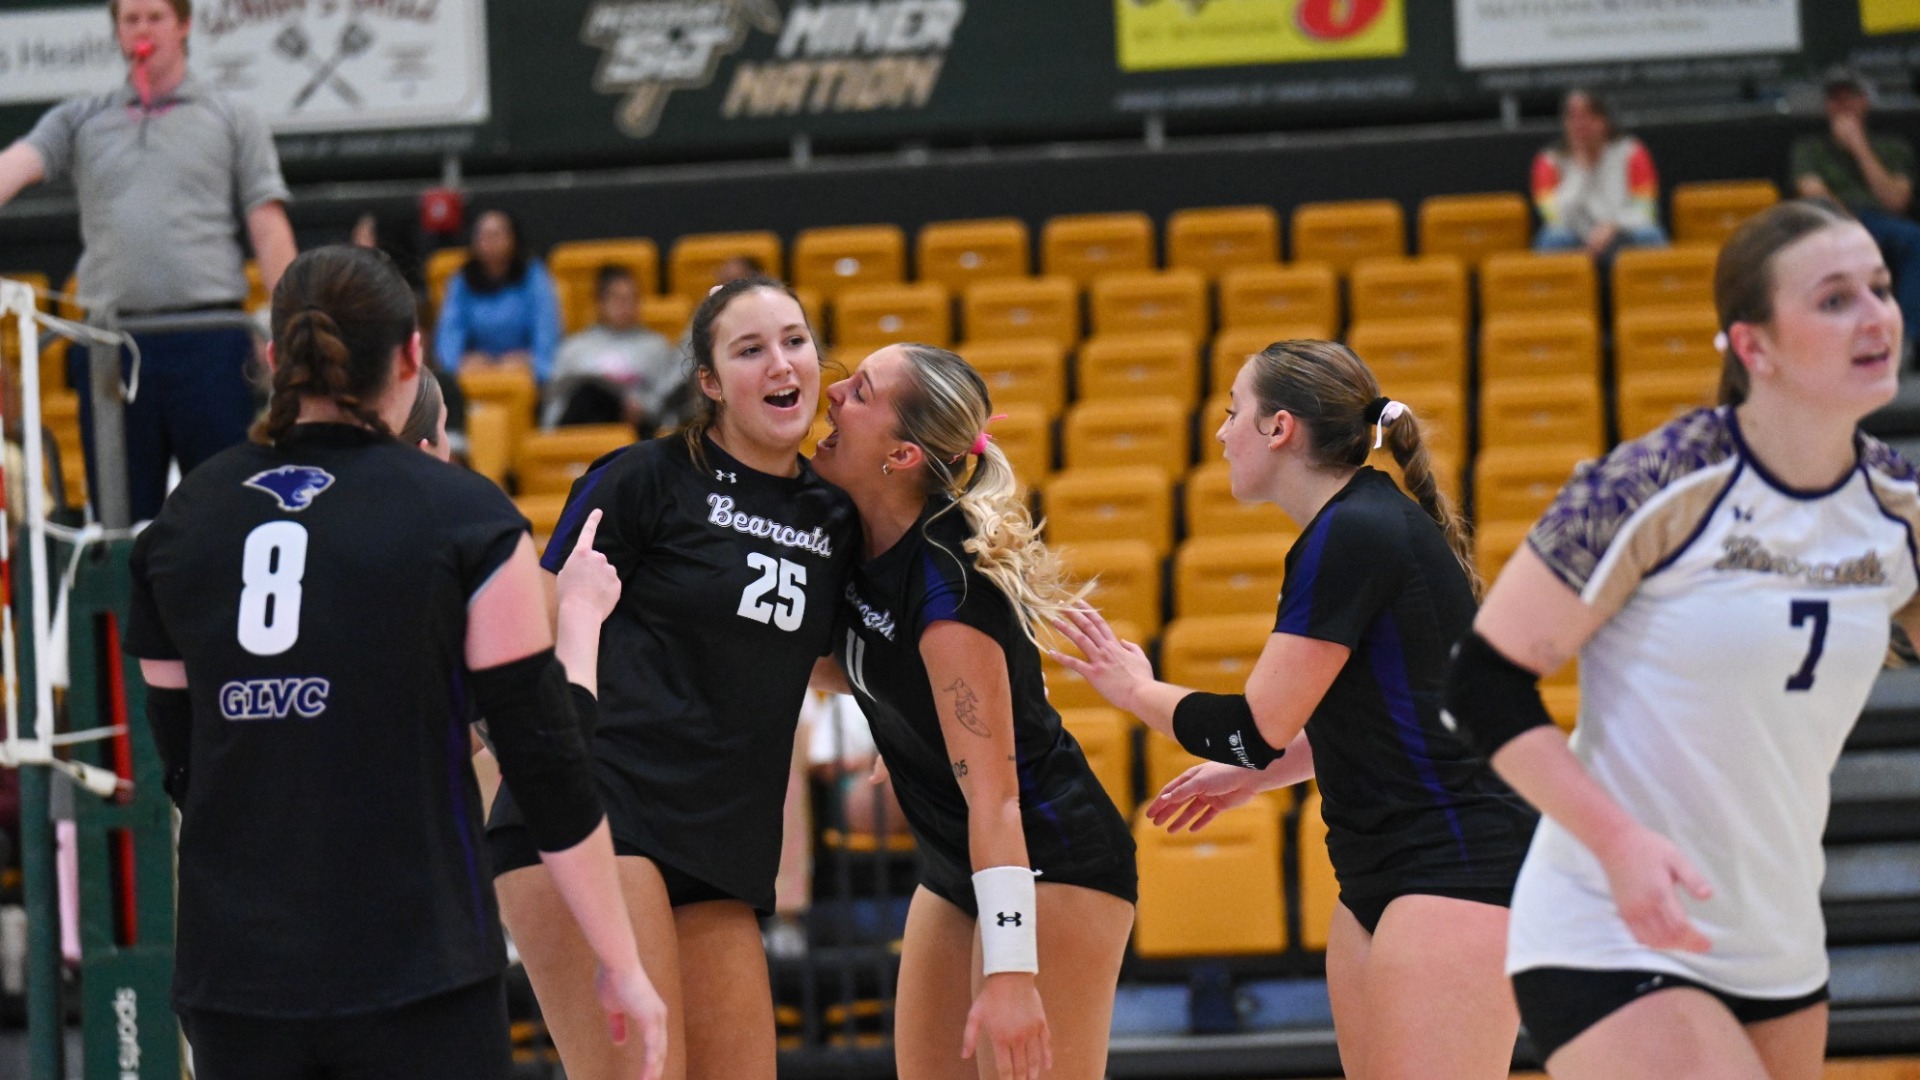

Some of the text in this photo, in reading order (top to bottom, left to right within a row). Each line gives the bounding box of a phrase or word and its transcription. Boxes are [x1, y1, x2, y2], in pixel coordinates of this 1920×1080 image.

[721, 55, 944, 119] NATION
[707, 493, 833, 558] Bearcats
[237, 520, 309, 656] 8
[737, 552, 807, 632] 25
[1785, 599, 1830, 691] 7
[219, 677, 330, 720] GLVC
